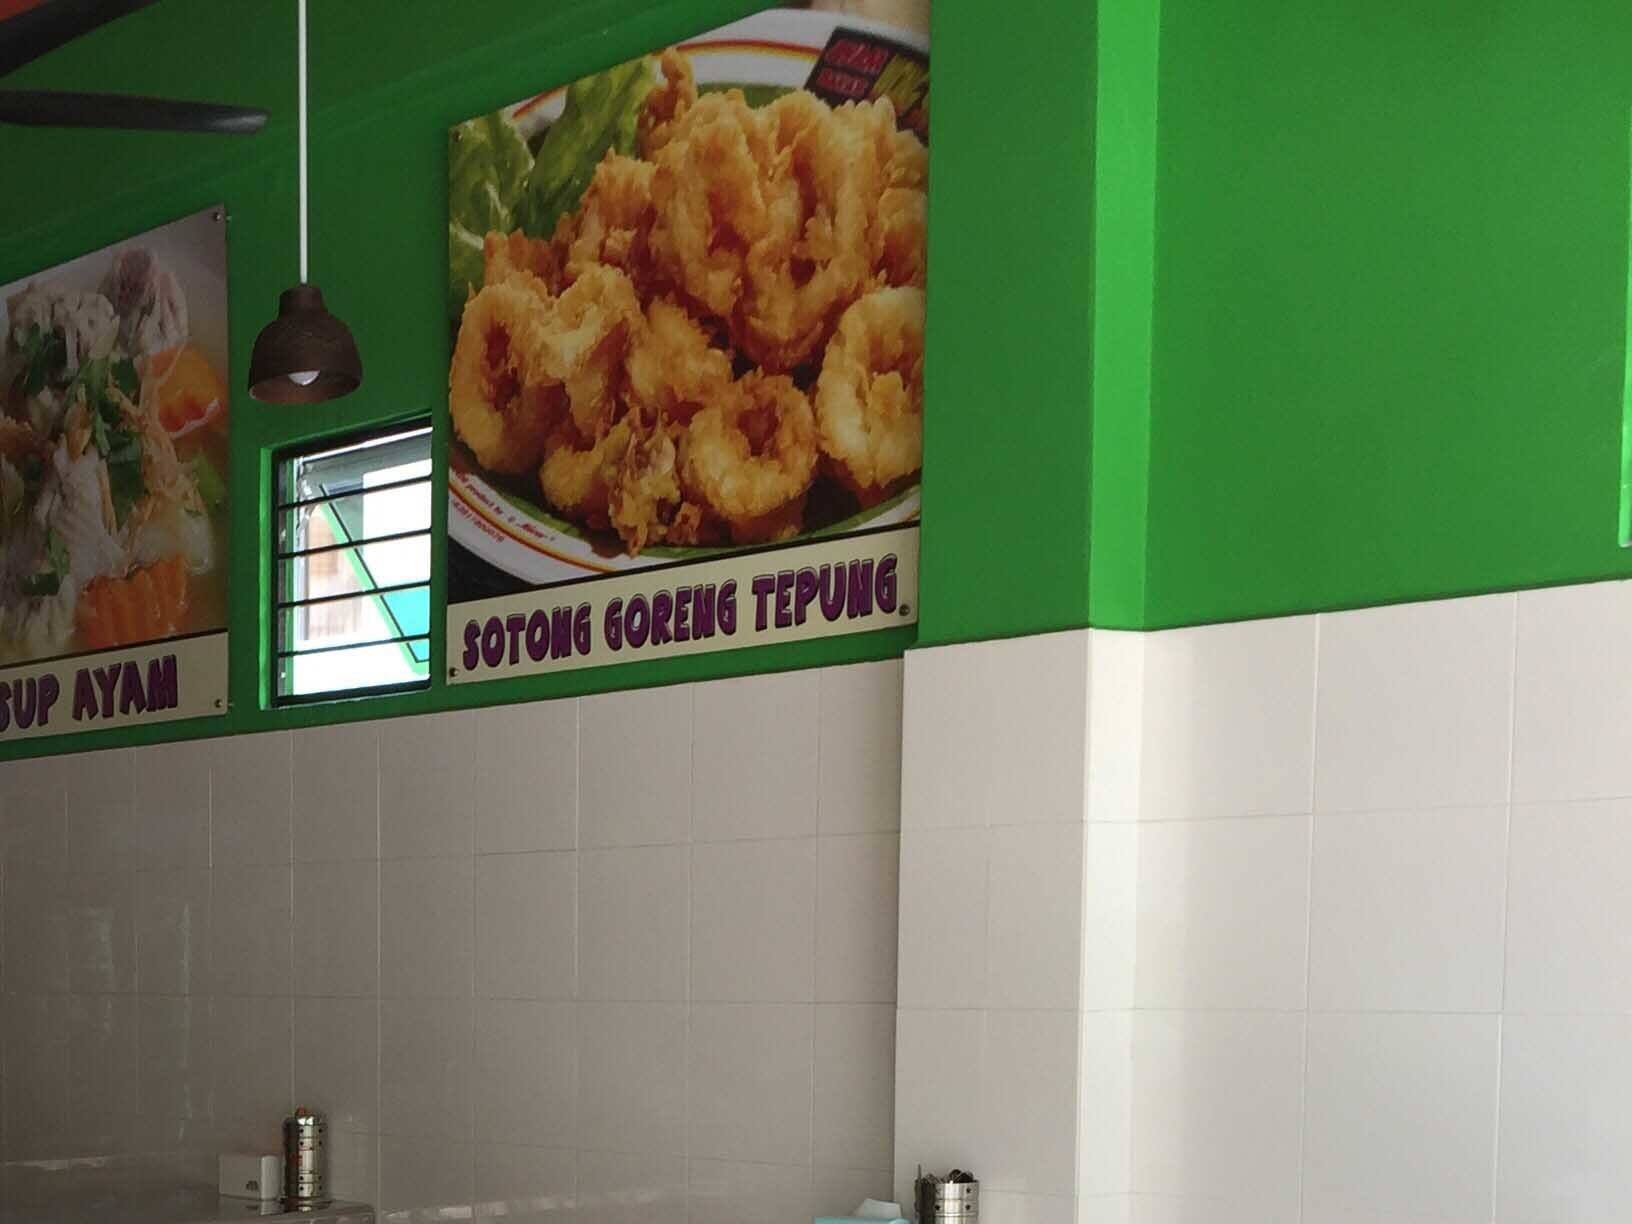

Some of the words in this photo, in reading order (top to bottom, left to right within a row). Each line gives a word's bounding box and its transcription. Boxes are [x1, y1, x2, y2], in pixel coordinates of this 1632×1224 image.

[462, 601, 591, 671] SOTONG
[604, 578, 738, 651] GORENG
[752, 553, 898, 633] TEPUNG
[72, 654, 178, 721] AYAM
